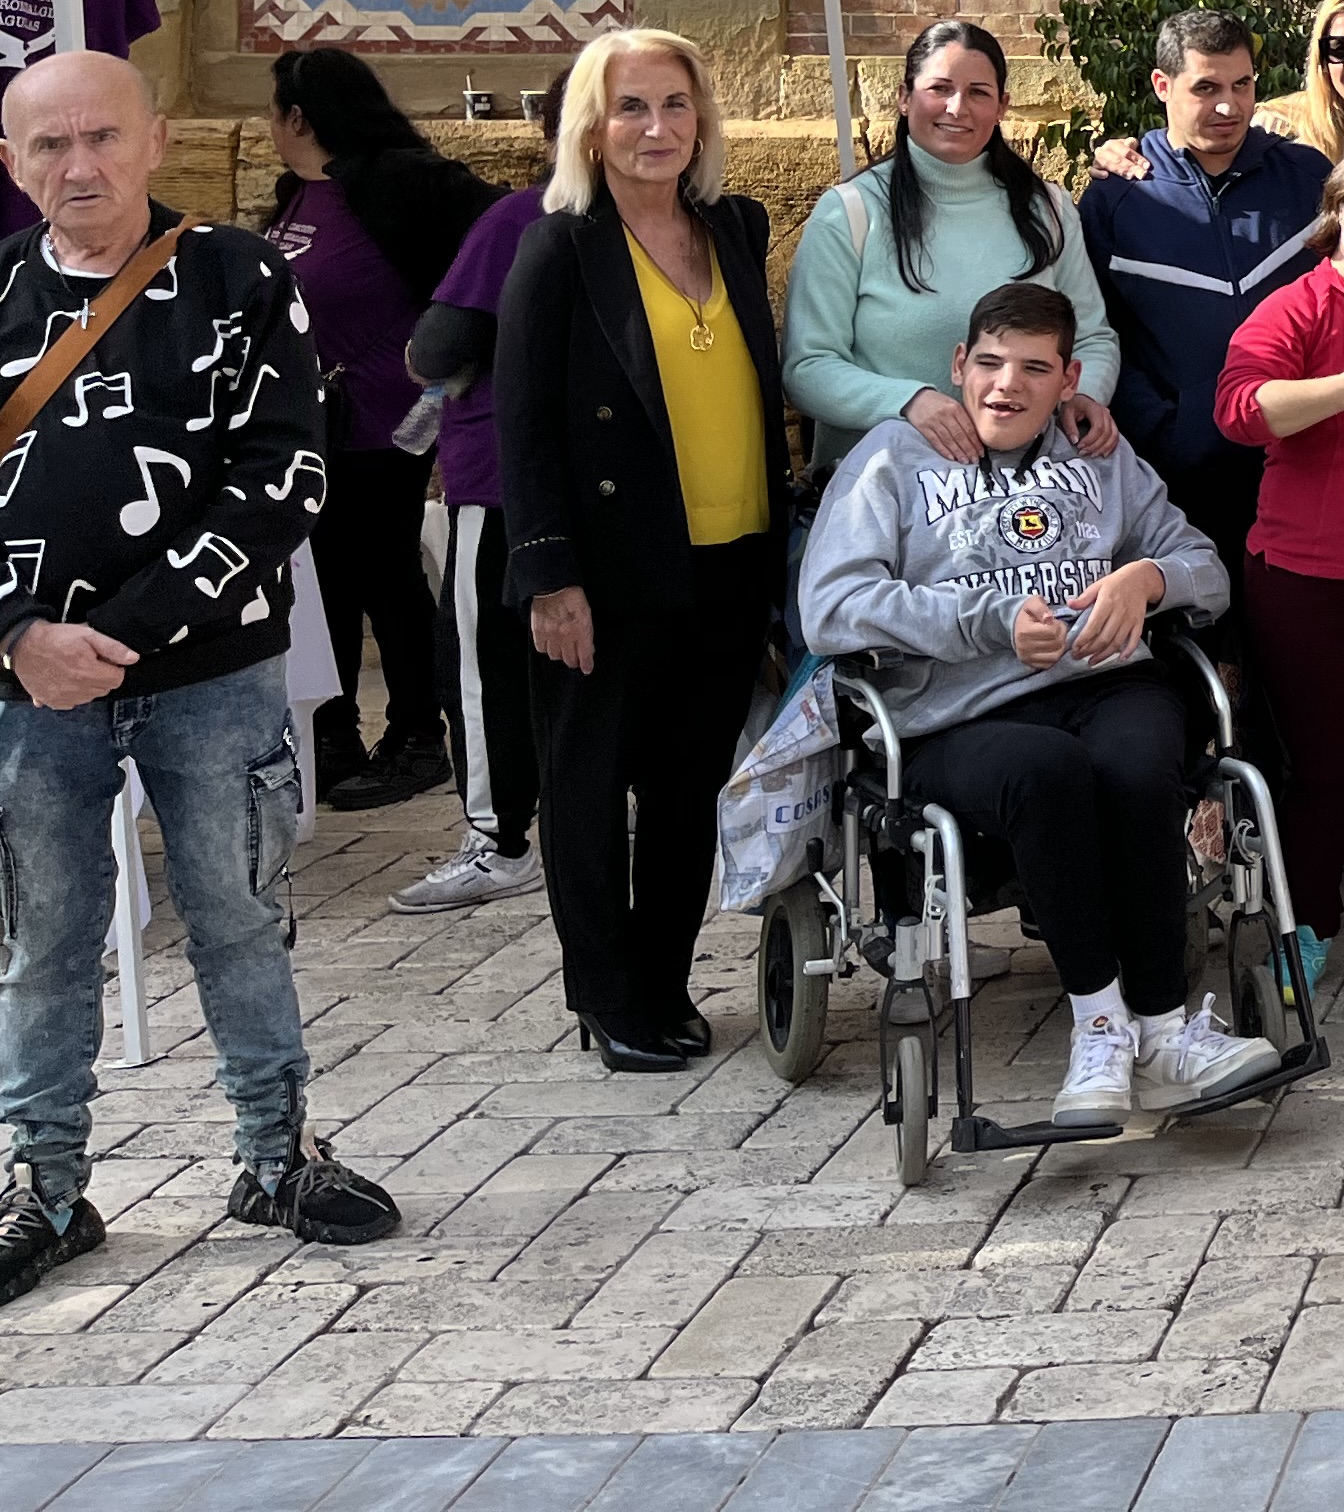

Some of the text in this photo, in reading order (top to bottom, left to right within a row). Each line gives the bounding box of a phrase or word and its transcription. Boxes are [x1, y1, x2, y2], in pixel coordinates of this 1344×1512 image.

[949, 520, 1102, 551] EST. 1123
[775, 785, 830, 824] COSAS
